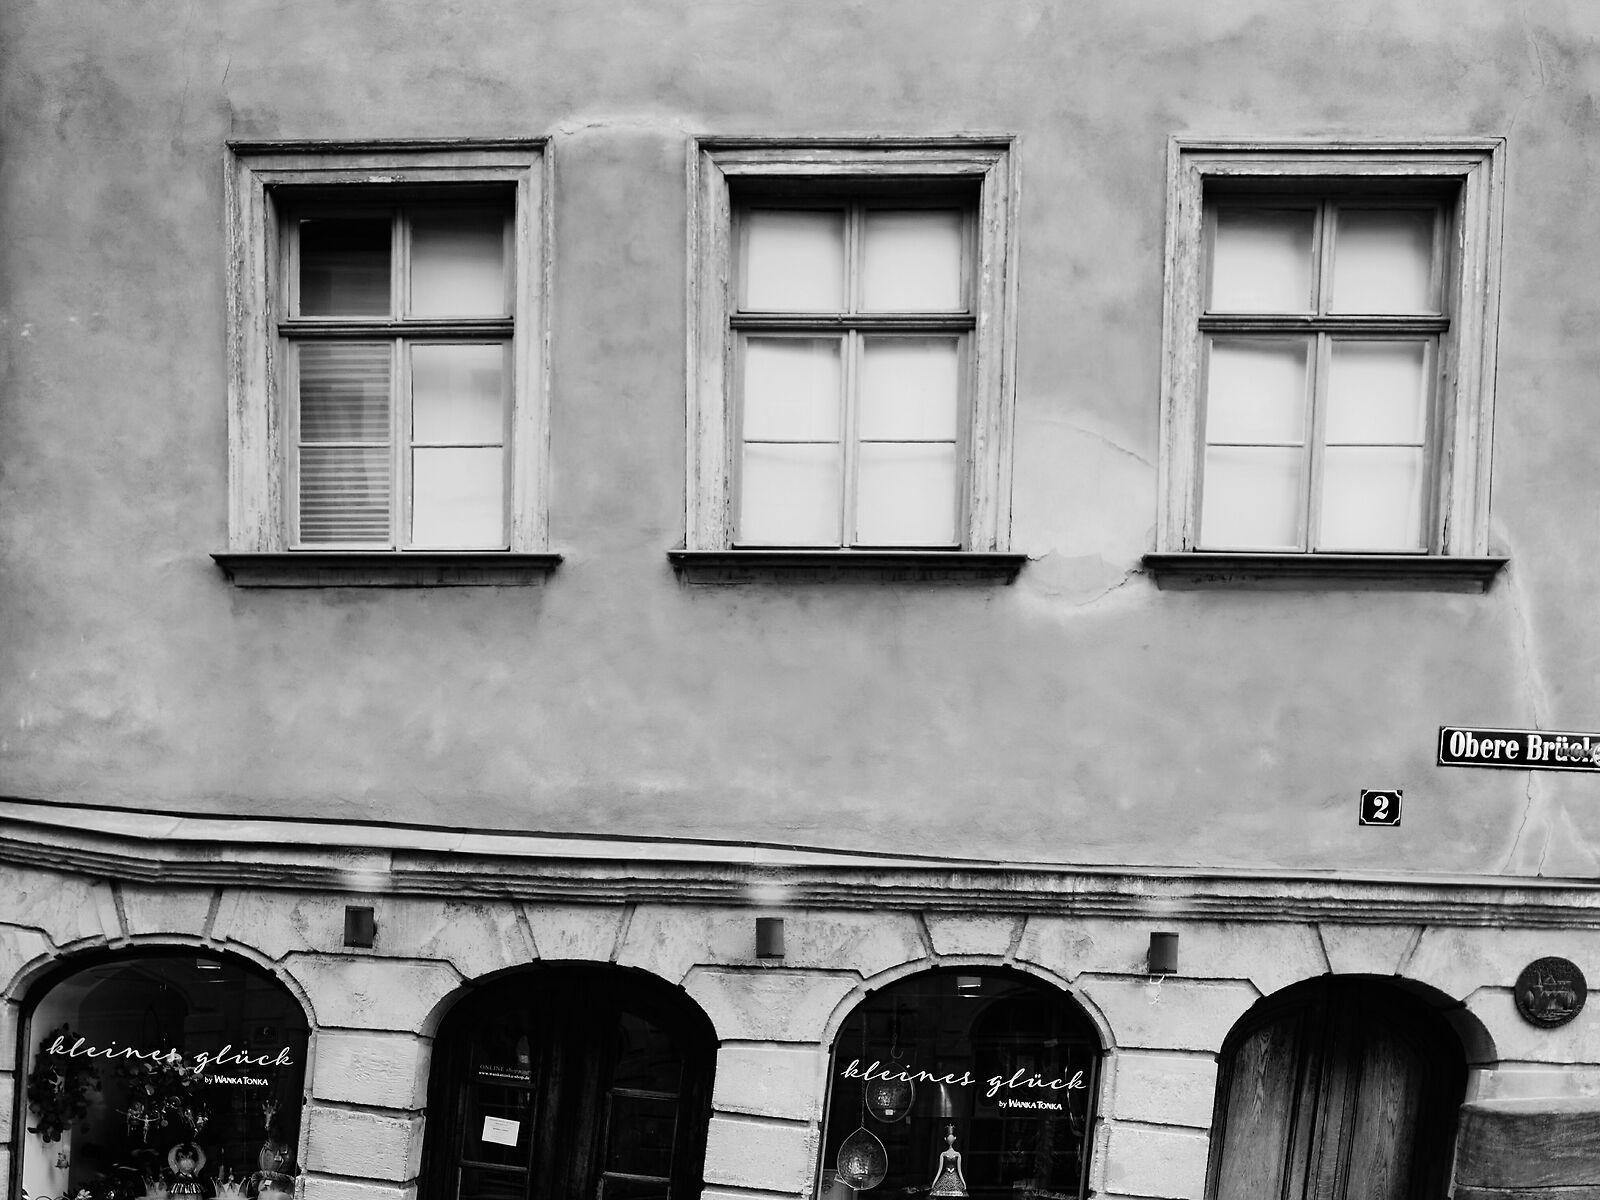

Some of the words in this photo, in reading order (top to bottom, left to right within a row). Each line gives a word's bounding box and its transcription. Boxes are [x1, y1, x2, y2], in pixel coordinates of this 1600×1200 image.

[1450, 731, 1520, 759] Obere
[1373, 795, 1389, 820] 2
[46, 1035, 181, 1063] kleines
[193, 1044, 294, 1074] glück
[204, 1076, 213, 1085] by
[840, 1059, 976, 1087] kleines
[986, 1067, 1087, 1098] glück
[998, 1100, 1008, 1109] by
